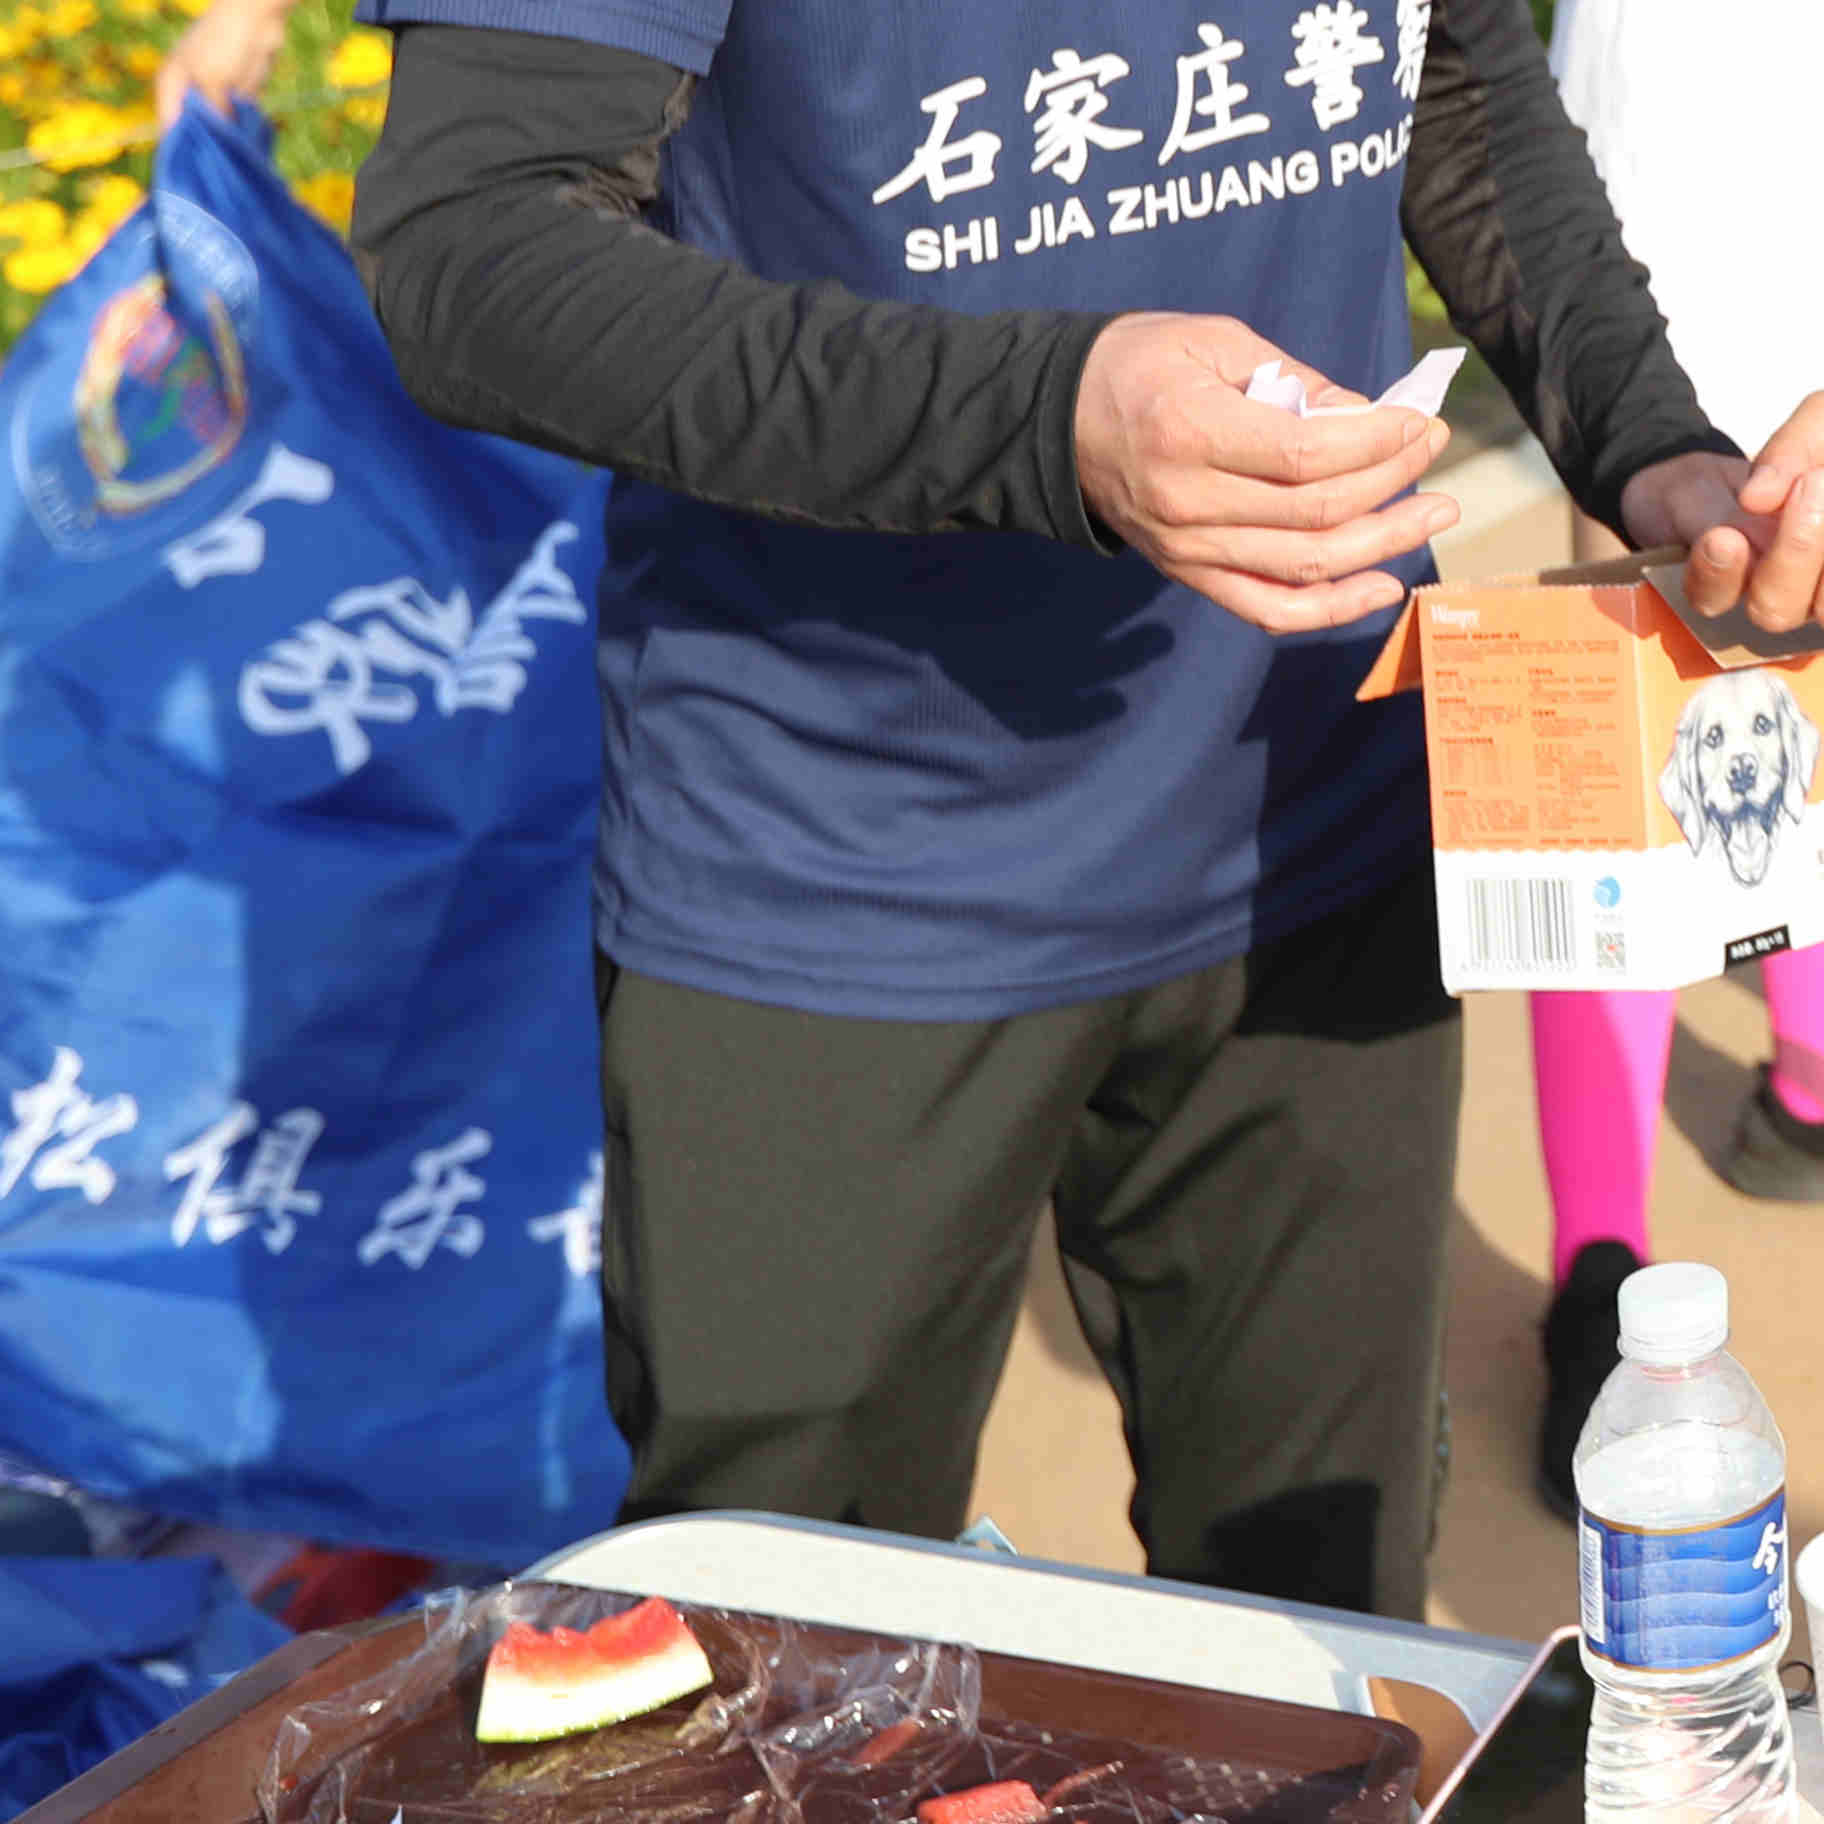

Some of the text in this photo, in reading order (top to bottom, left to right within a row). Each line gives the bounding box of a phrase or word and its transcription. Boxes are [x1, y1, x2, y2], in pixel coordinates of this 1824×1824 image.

[904, 216, 1000, 272] SHI
[1013, 196, 1096, 255] JIA
[1106, 150, 1320, 235] ZHUANG
